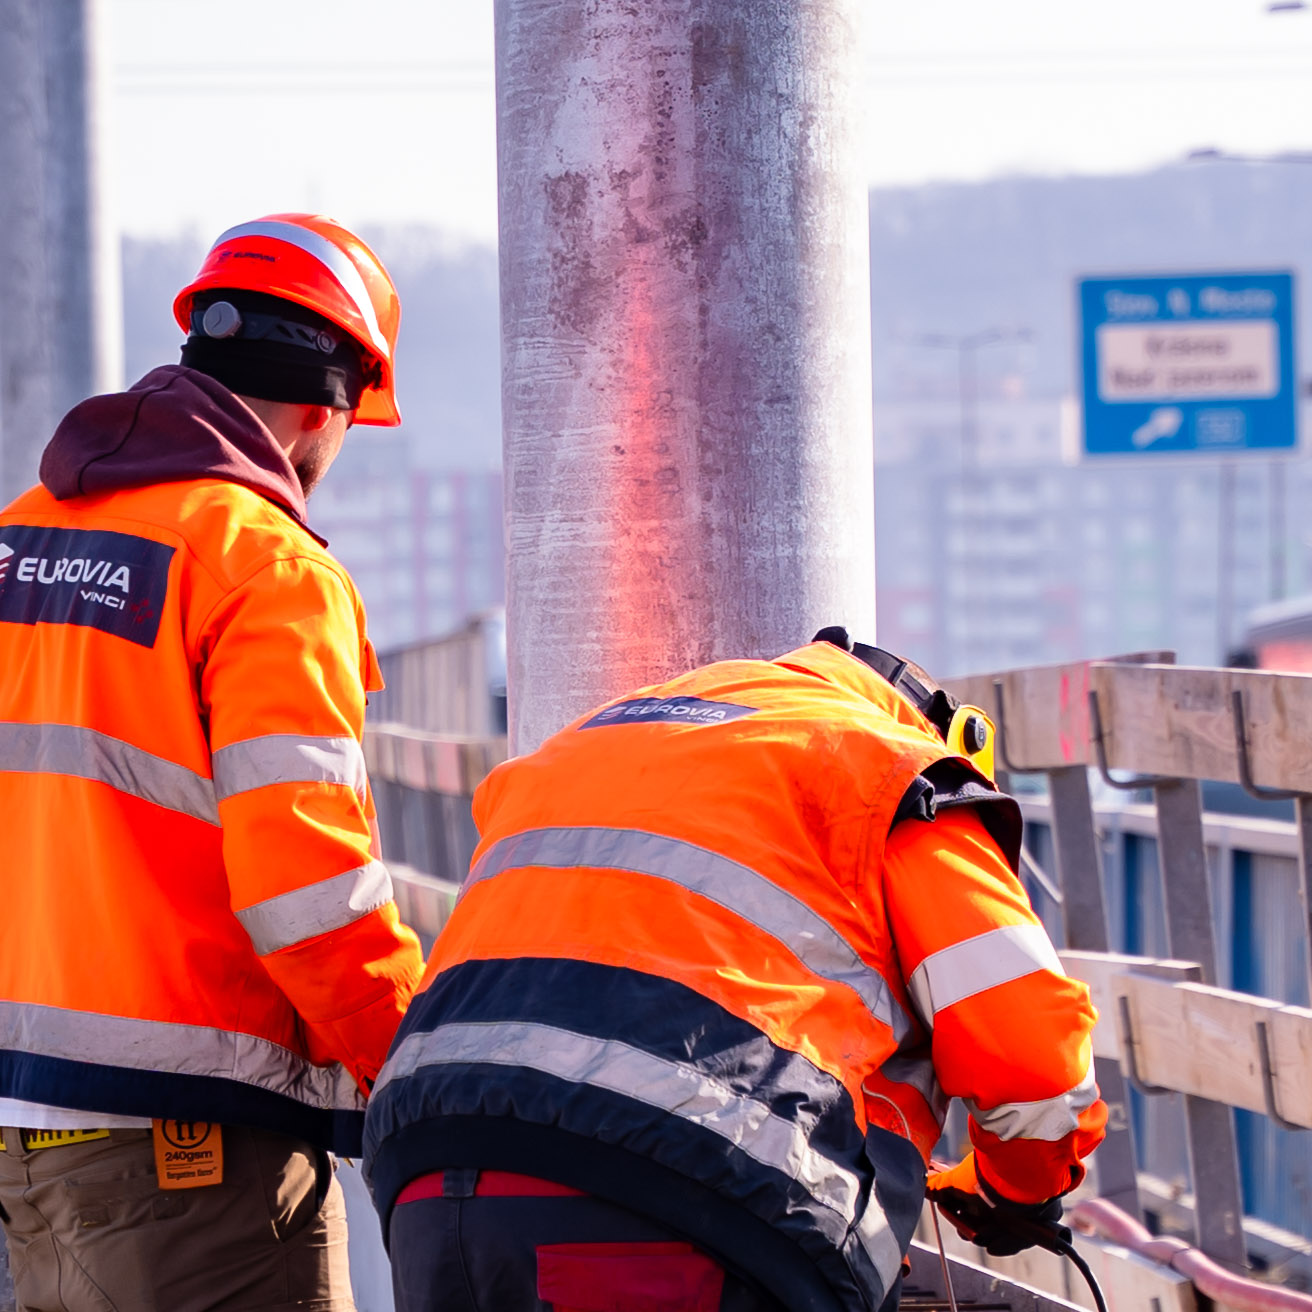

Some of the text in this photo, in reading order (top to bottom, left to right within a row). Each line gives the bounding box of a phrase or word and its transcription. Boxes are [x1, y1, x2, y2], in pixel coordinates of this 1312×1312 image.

[17, 557, 130, 594] EUROVIA
[80, 590, 125, 610] VINCI
[624, 704, 727, 720] EUROVIA
[164, 1150, 213, 1163] 240gsm
